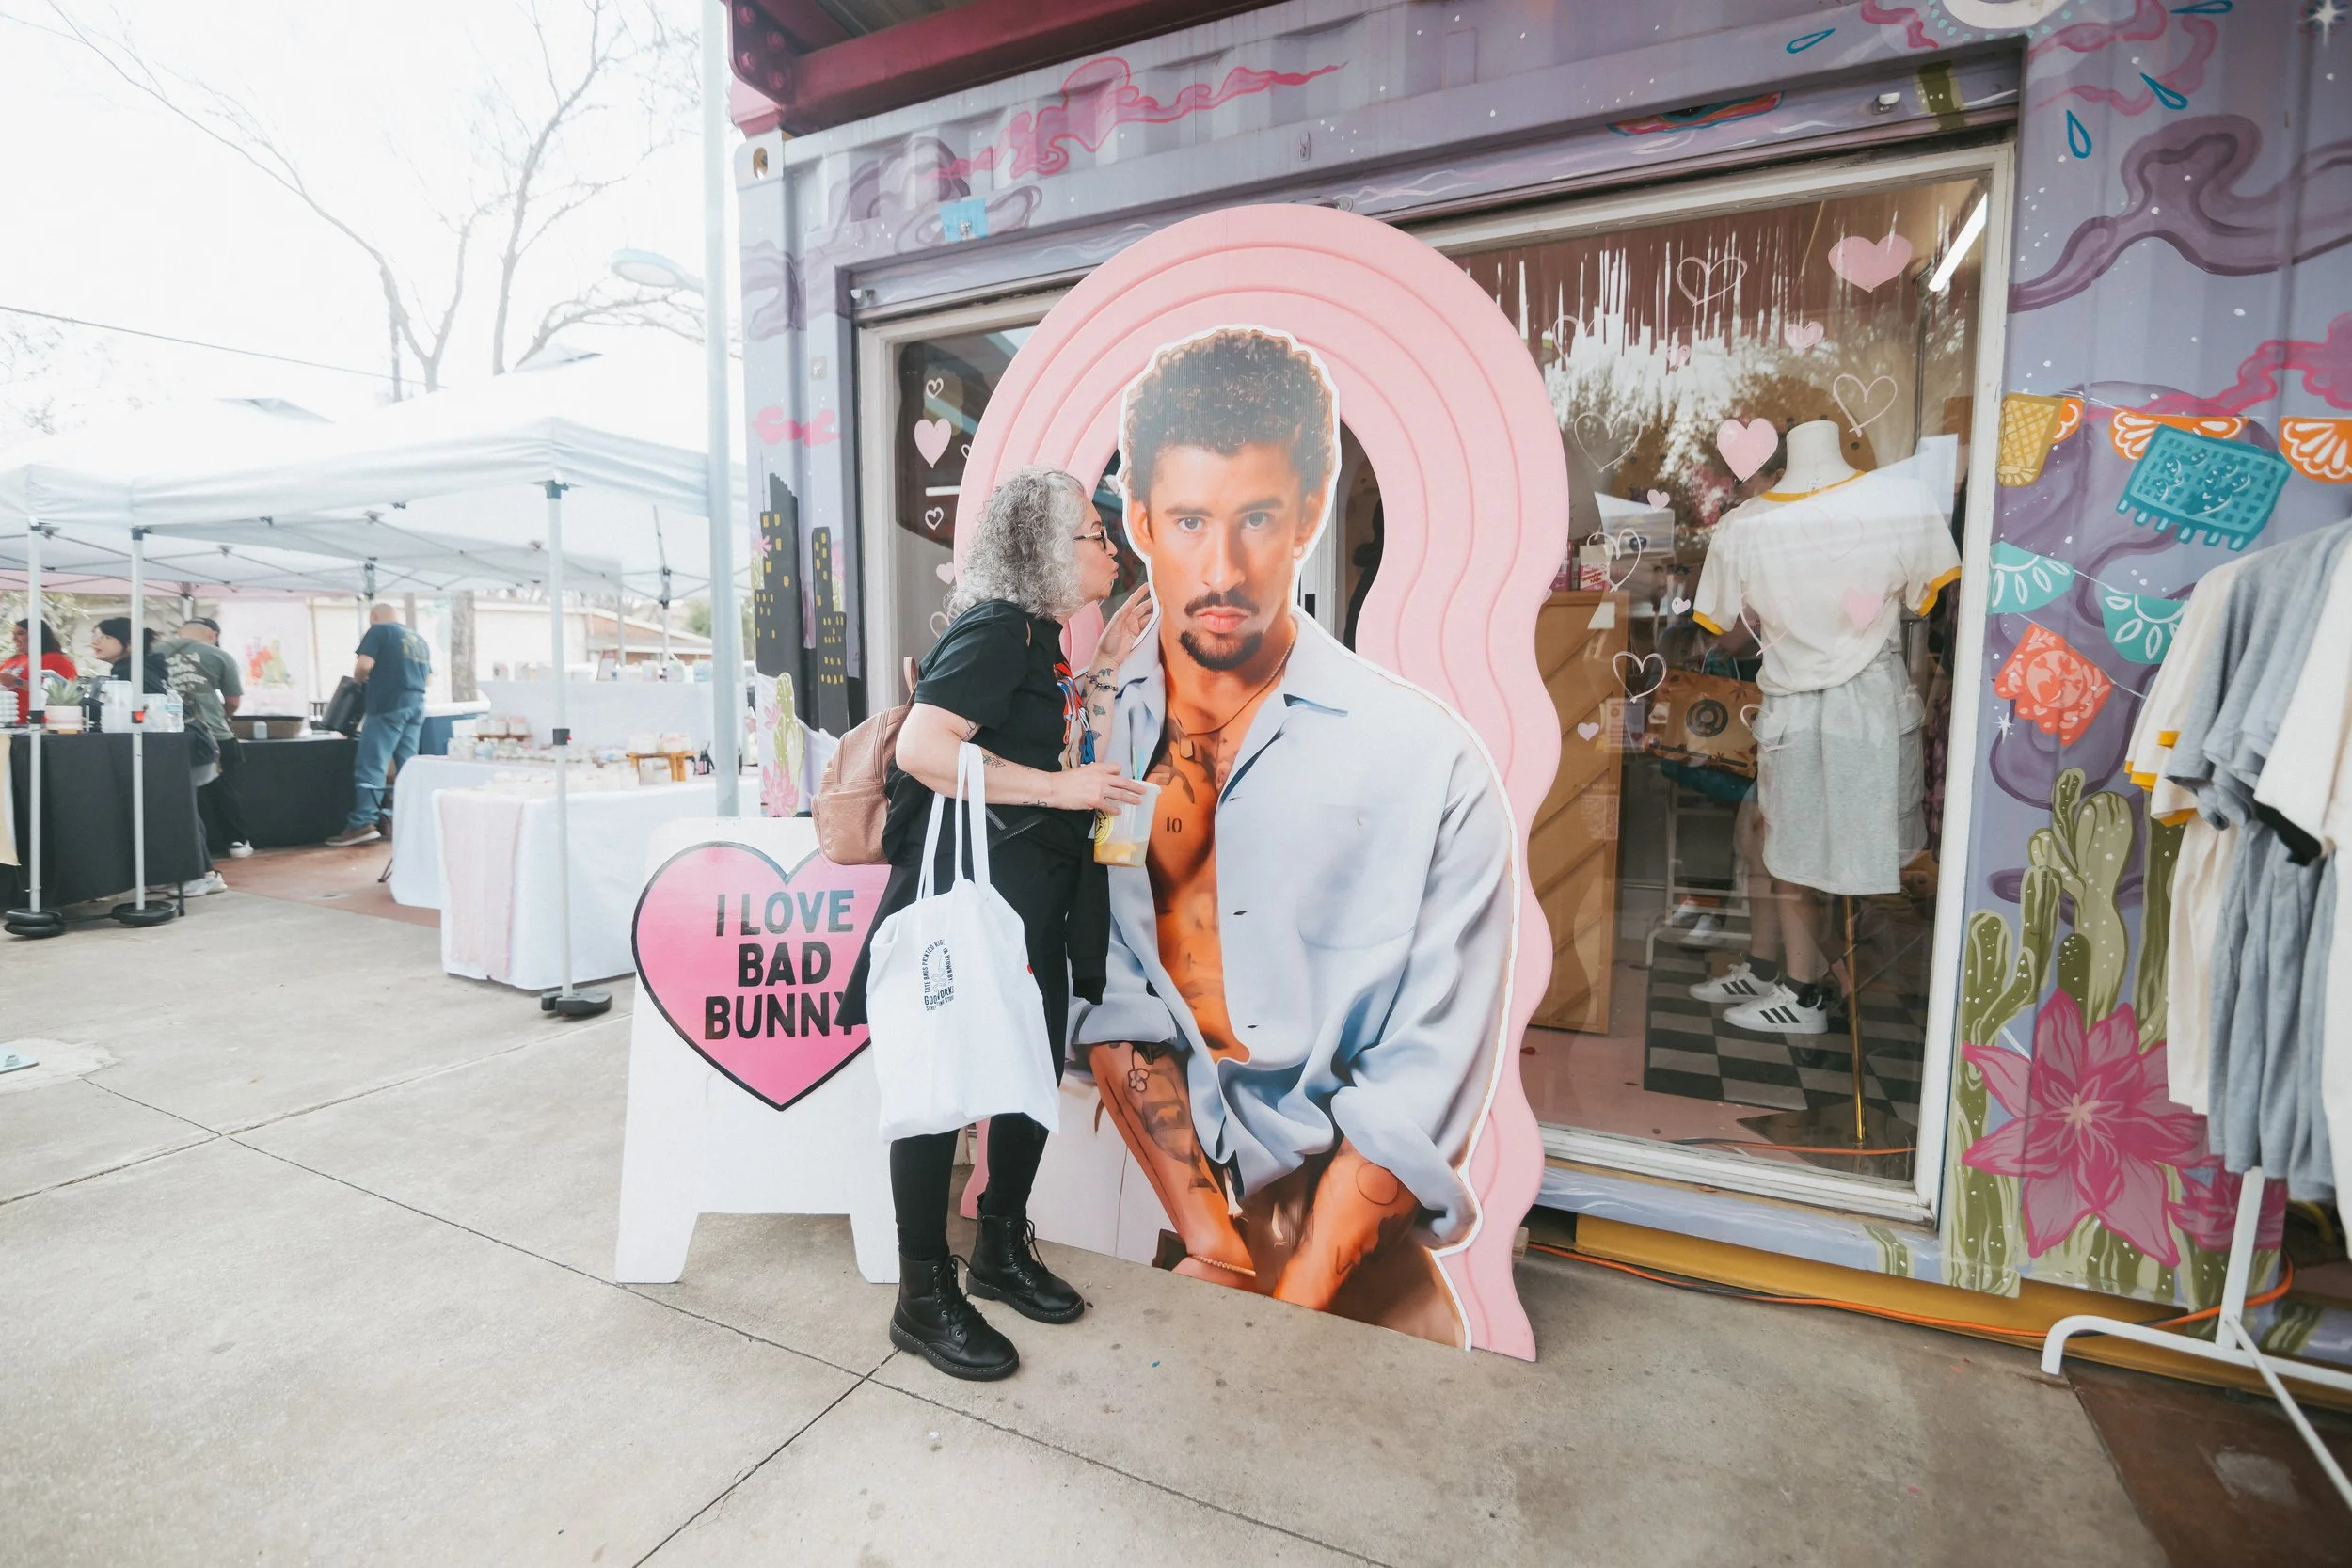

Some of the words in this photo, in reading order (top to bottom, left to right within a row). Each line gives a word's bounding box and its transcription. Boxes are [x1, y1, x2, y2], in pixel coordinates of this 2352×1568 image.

[716, 894, 725, 937] I
[740, 889, 854, 936] LOVE
[738, 941, 832, 988] BAD
[922, 944, 934, 965] PRINTED
